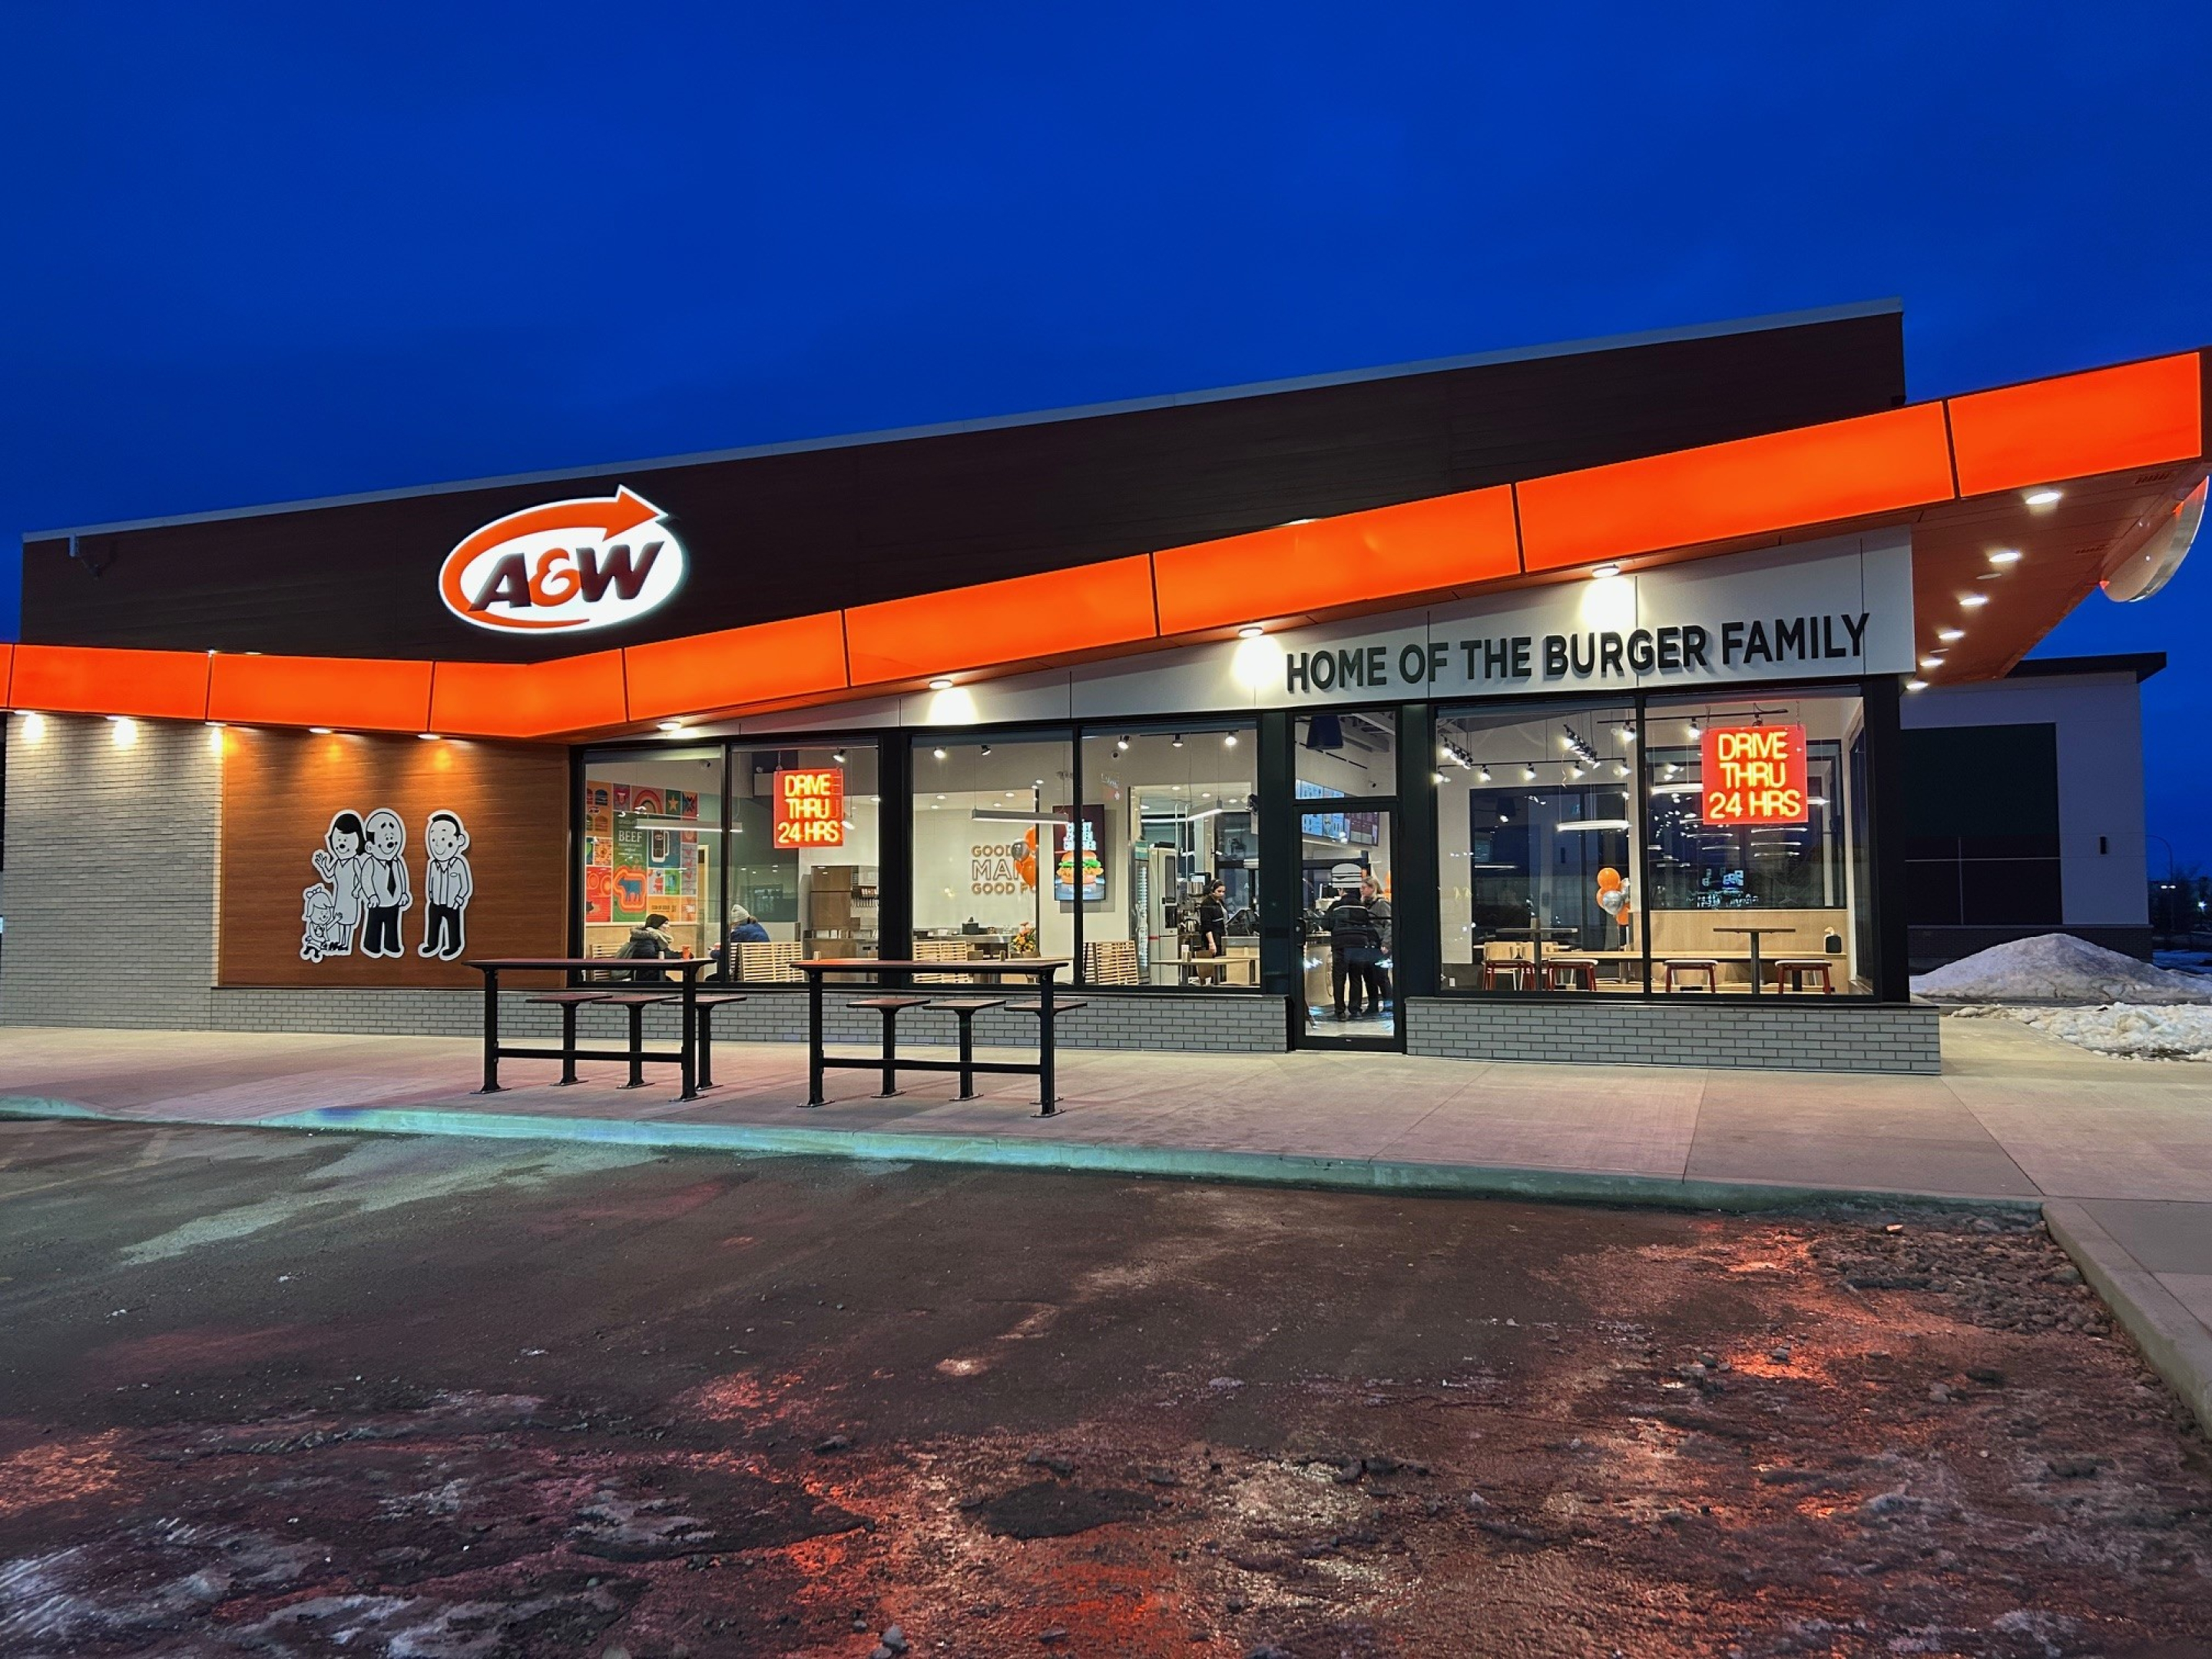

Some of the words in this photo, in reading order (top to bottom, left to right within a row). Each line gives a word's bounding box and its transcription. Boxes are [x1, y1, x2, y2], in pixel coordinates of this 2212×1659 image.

[468, 541, 665, 612] A&W
[1286, 646, 1387, 693] HOME
[1399, 642, 1449, 684] OF
[1460, 636, 1532, 680] THE
[1545, 624, 1707, 677] BURGER
[1721, 613, 1870, 665] FAMILY
[1718, 731, 1789, 761] DRIVE
[784, 773, 832, 797] DRIVE
[1719, 760, 1786, 790] THRU
[784, 797, 830, 820] THRU
[1709, 791, 1743, 820] 24
[1748, 789, 1802, 818] HRS
[618, 830, 643, 843] BEEF
[777, 821, 802, 843] 24
[803, 820, 840, 843] HRS
[971, 882, 1016, 895] GOOD
